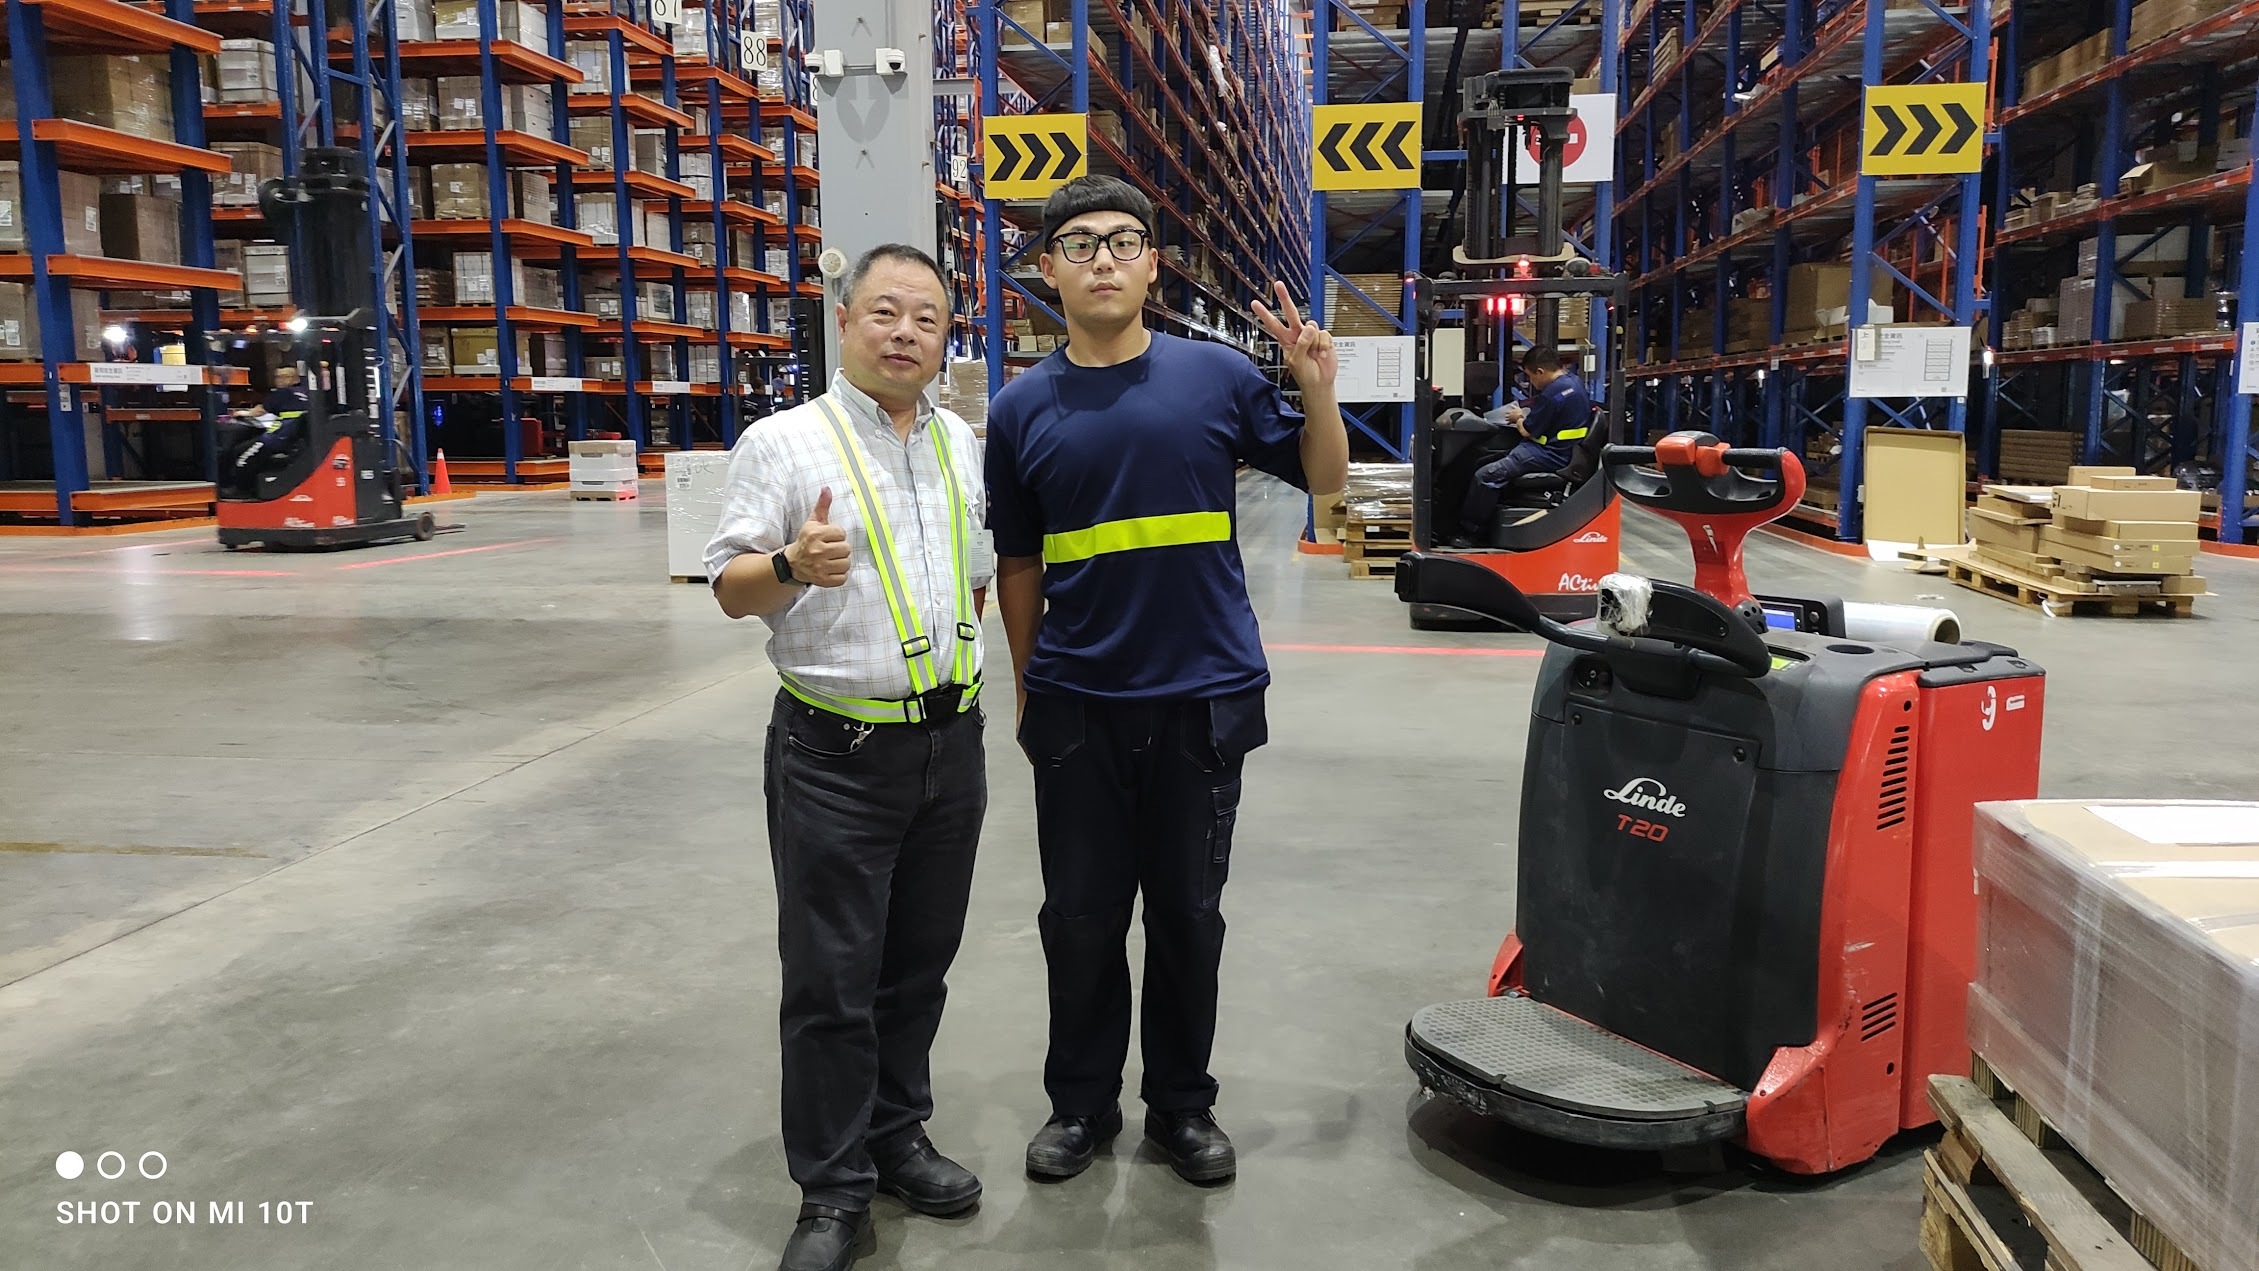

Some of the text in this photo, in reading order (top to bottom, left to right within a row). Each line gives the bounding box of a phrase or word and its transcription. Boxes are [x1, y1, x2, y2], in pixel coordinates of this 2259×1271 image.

[743, 36, 766, 66] 88
[952, 158, 967, 179] 92
[1572, 531, 1609, 543] Linde
[1603, 777, 1687, 818] Linde
[1617, 813, 1669, 842] T20
